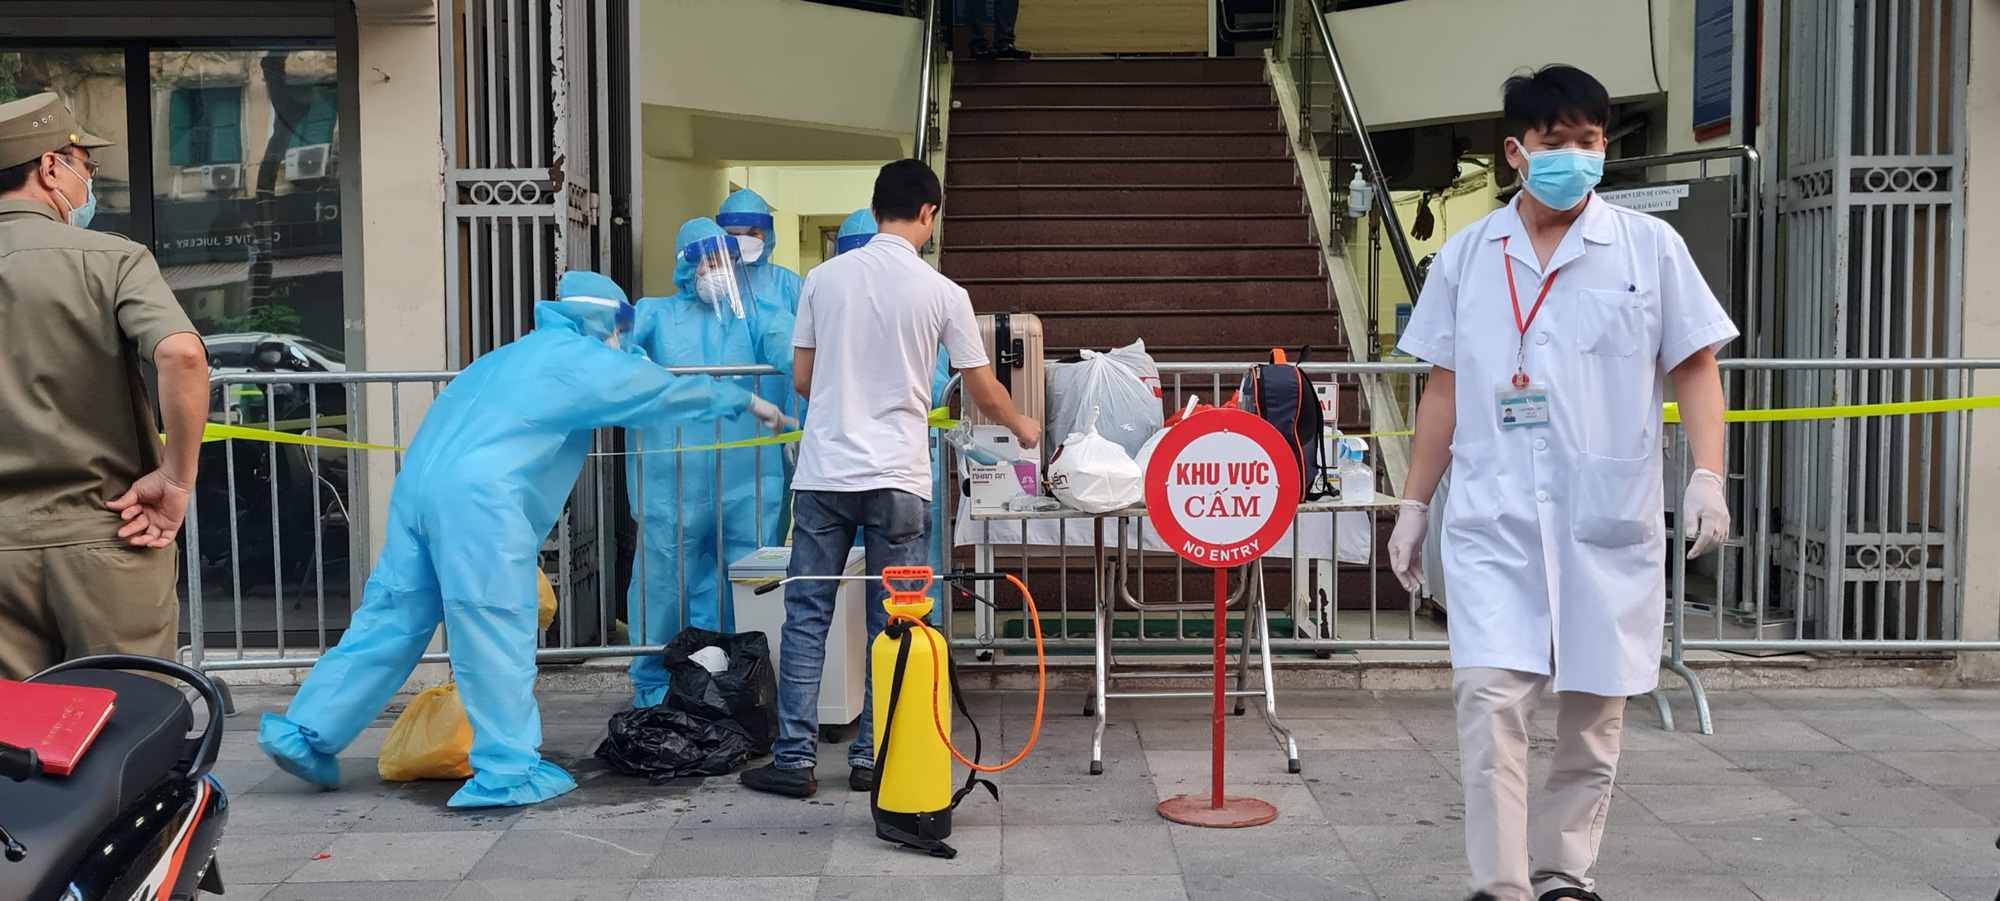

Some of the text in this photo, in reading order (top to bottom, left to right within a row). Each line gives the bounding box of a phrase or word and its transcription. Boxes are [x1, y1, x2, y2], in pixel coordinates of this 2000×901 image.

[1176, 460, 1270, 490] KHU VỰC
[1184, 487, 1261, 518] CẤM
[1183, 538, 1260, 562] NO ENTRY
